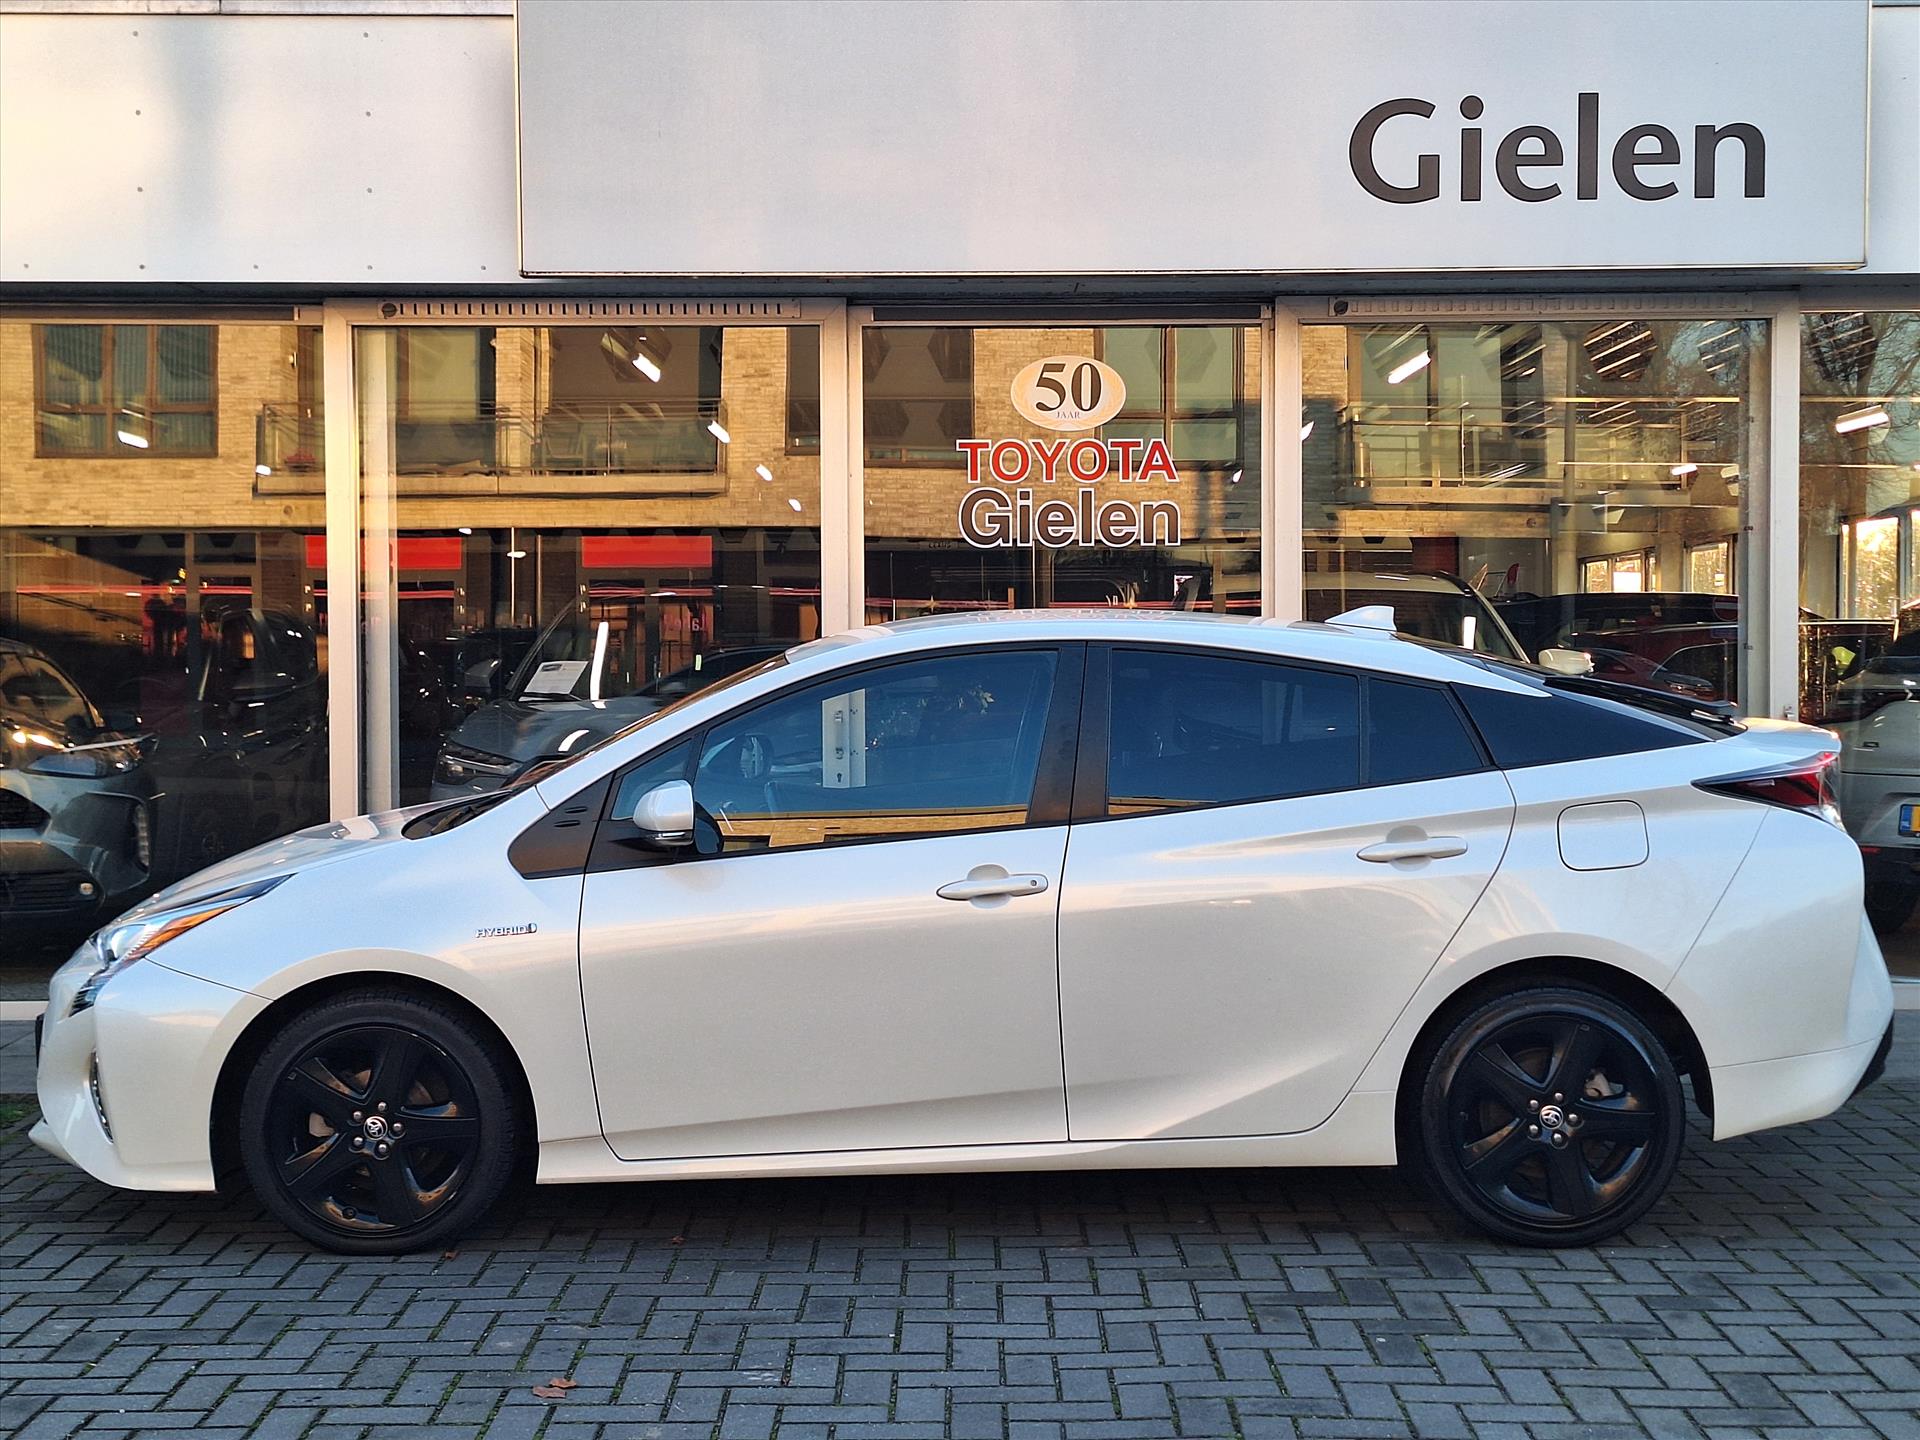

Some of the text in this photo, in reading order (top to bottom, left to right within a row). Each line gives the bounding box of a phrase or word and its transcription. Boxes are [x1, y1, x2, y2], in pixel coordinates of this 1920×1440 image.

[1349, 92, 1766, 204] Gielen
[1034, 362, 1102, 412] 50
[1056, 411, 1081, 419] JAAR
[956, 439, 1180, 484] TOYOTA
[959, 487, 1182, 549] Gielen
[475, 924, 529, 938] HYBRID
